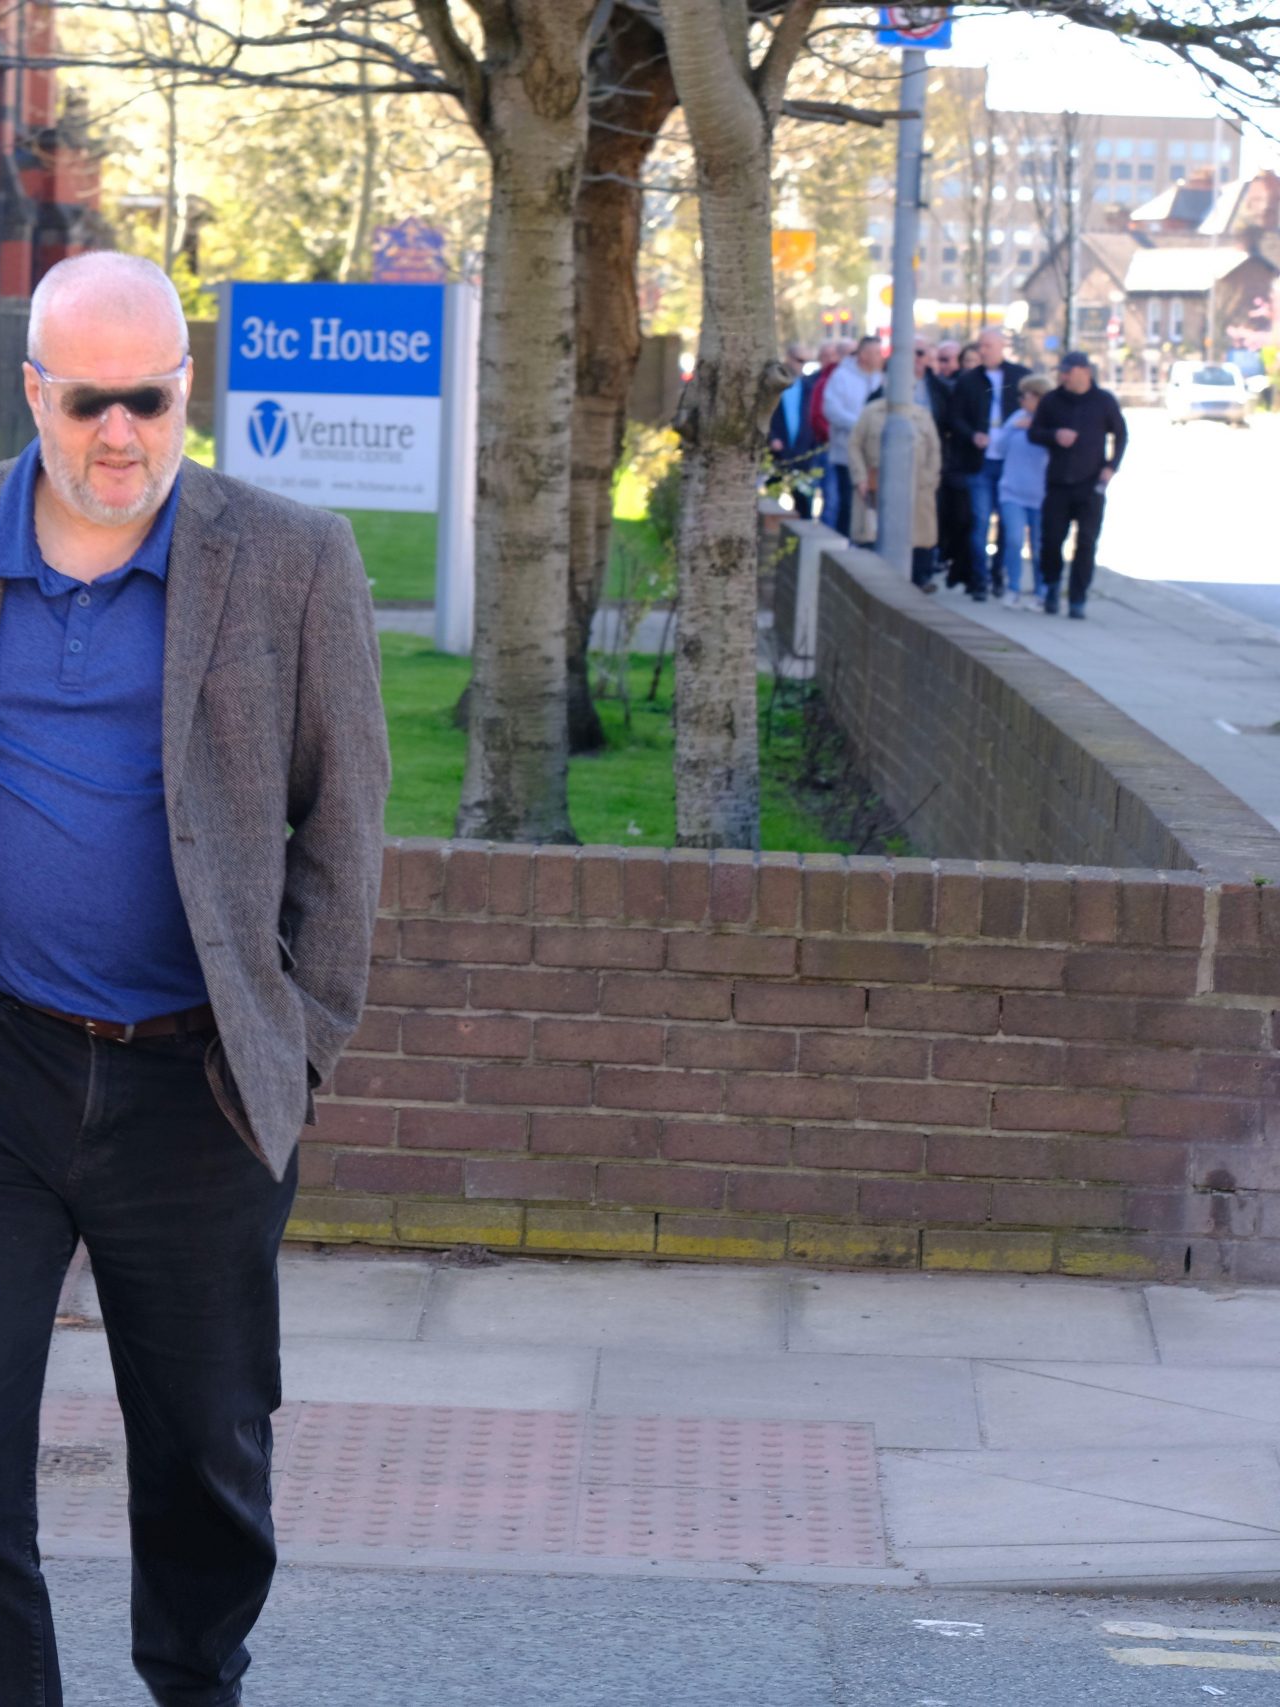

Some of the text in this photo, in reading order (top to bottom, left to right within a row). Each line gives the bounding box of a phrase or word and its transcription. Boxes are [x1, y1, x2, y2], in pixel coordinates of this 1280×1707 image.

[240, 316, 431, 362] 3tc House
[291, 412, 414, 449] Venture
